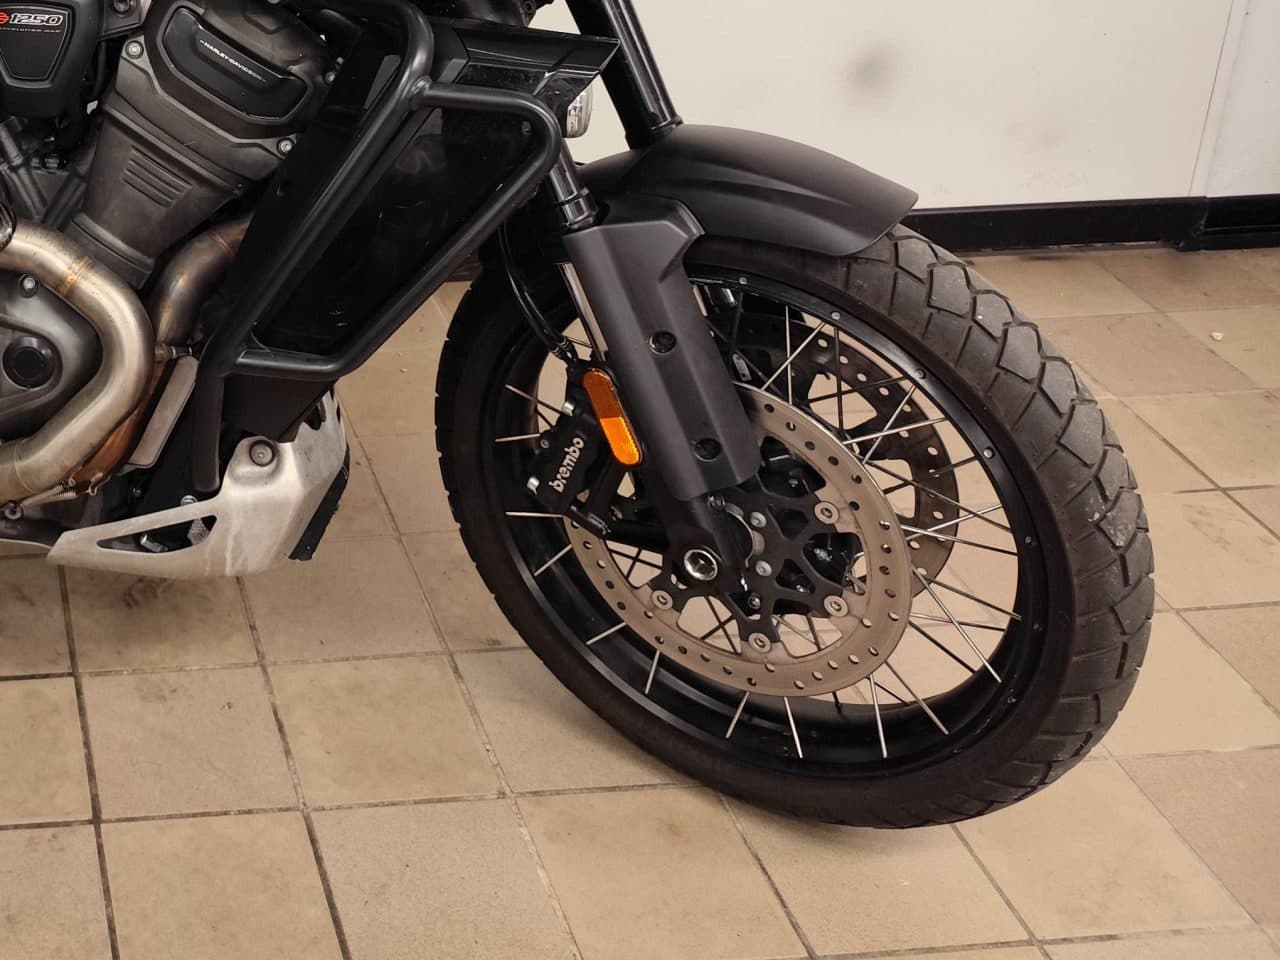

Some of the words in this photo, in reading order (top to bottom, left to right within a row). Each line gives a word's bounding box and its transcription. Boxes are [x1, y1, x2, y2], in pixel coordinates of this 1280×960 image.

[9, 13, 63, 26] 1250
[202, 41, 263, 80] HARLEY-DAVIDSON
[548, 437, 584, 493] brembo
